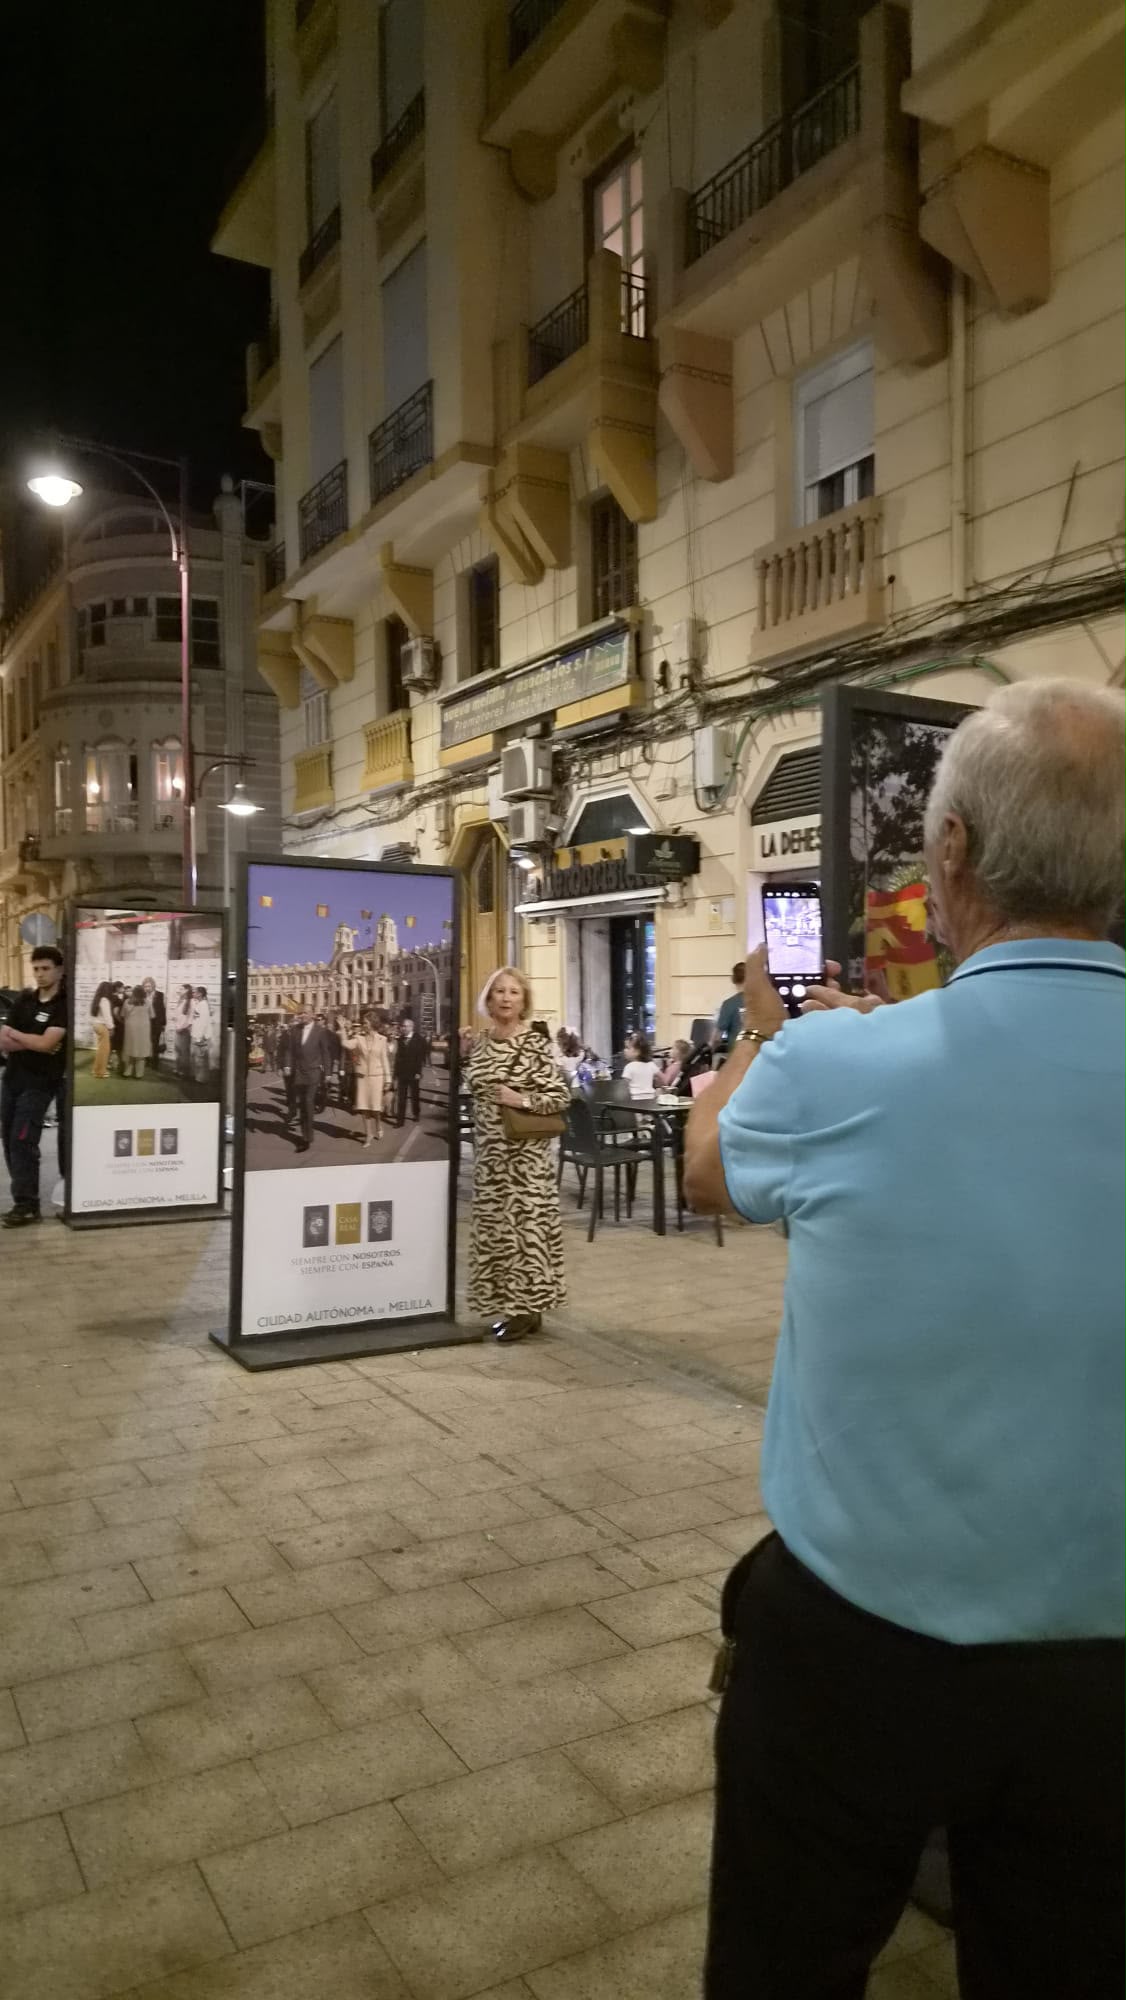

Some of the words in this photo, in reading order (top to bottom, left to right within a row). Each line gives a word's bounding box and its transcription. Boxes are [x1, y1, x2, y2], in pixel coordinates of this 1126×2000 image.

[761, 833, 777, 858] LA
[291, 1254, 327, 1266] SIEMPRE
[330, 1253, 350, 1263] CON
[301, 1263, 336, 1275] SIEMPRE
[257, 1312, 302, 1328] CIUDAD
[306, 1305, 375, 1323] AUTÓNOMA
[389, 1299, 432, 1312] MELILLA
